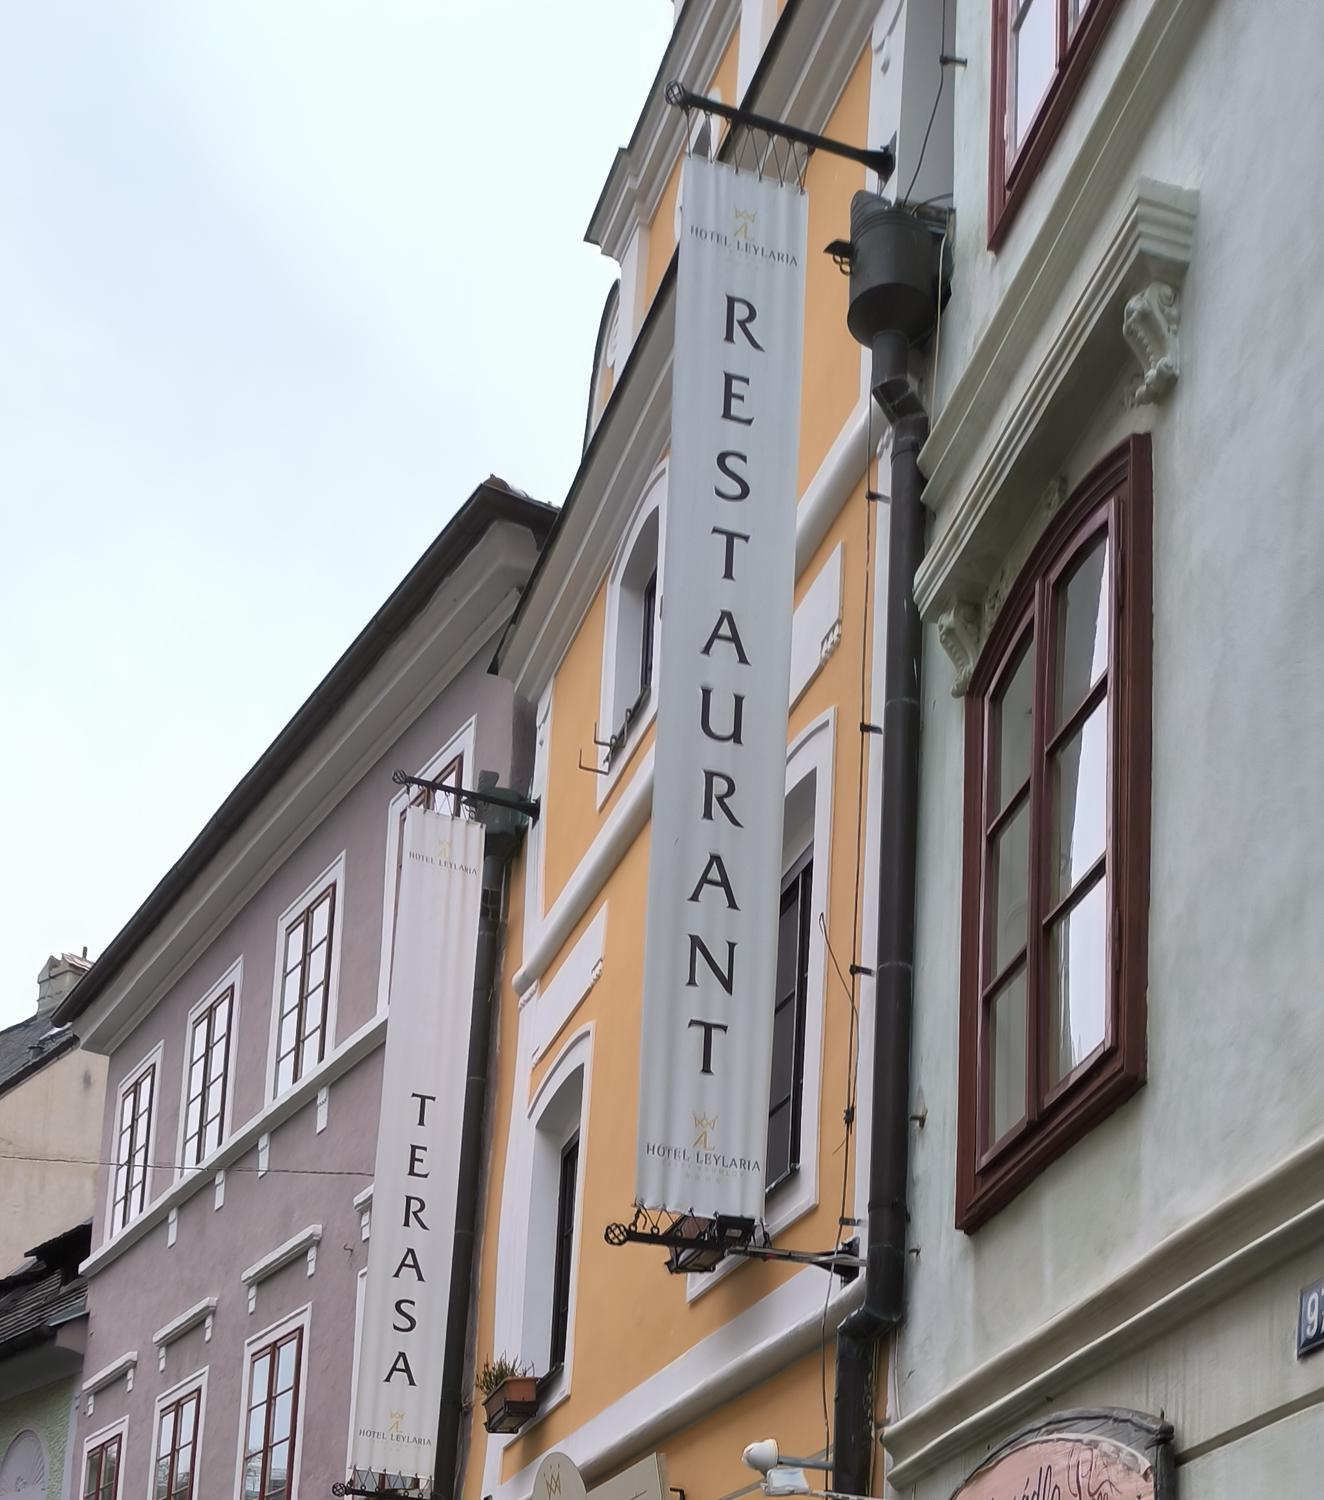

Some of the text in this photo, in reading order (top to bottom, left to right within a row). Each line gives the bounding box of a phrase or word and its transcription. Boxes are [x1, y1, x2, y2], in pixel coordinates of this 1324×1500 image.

[690, 224, 798, 268] HOTEL LEYLARIA
[685, 294, 765, 1076] RESTAURANT
[646, 1142, 689, 1161] HOTEL
[696, 1151, 760, 1173] LEYLARIA
[383, 1092, 436, 1387] TERASA
[359, 1428, 432, 1447] HOTEL LEYLARIA
